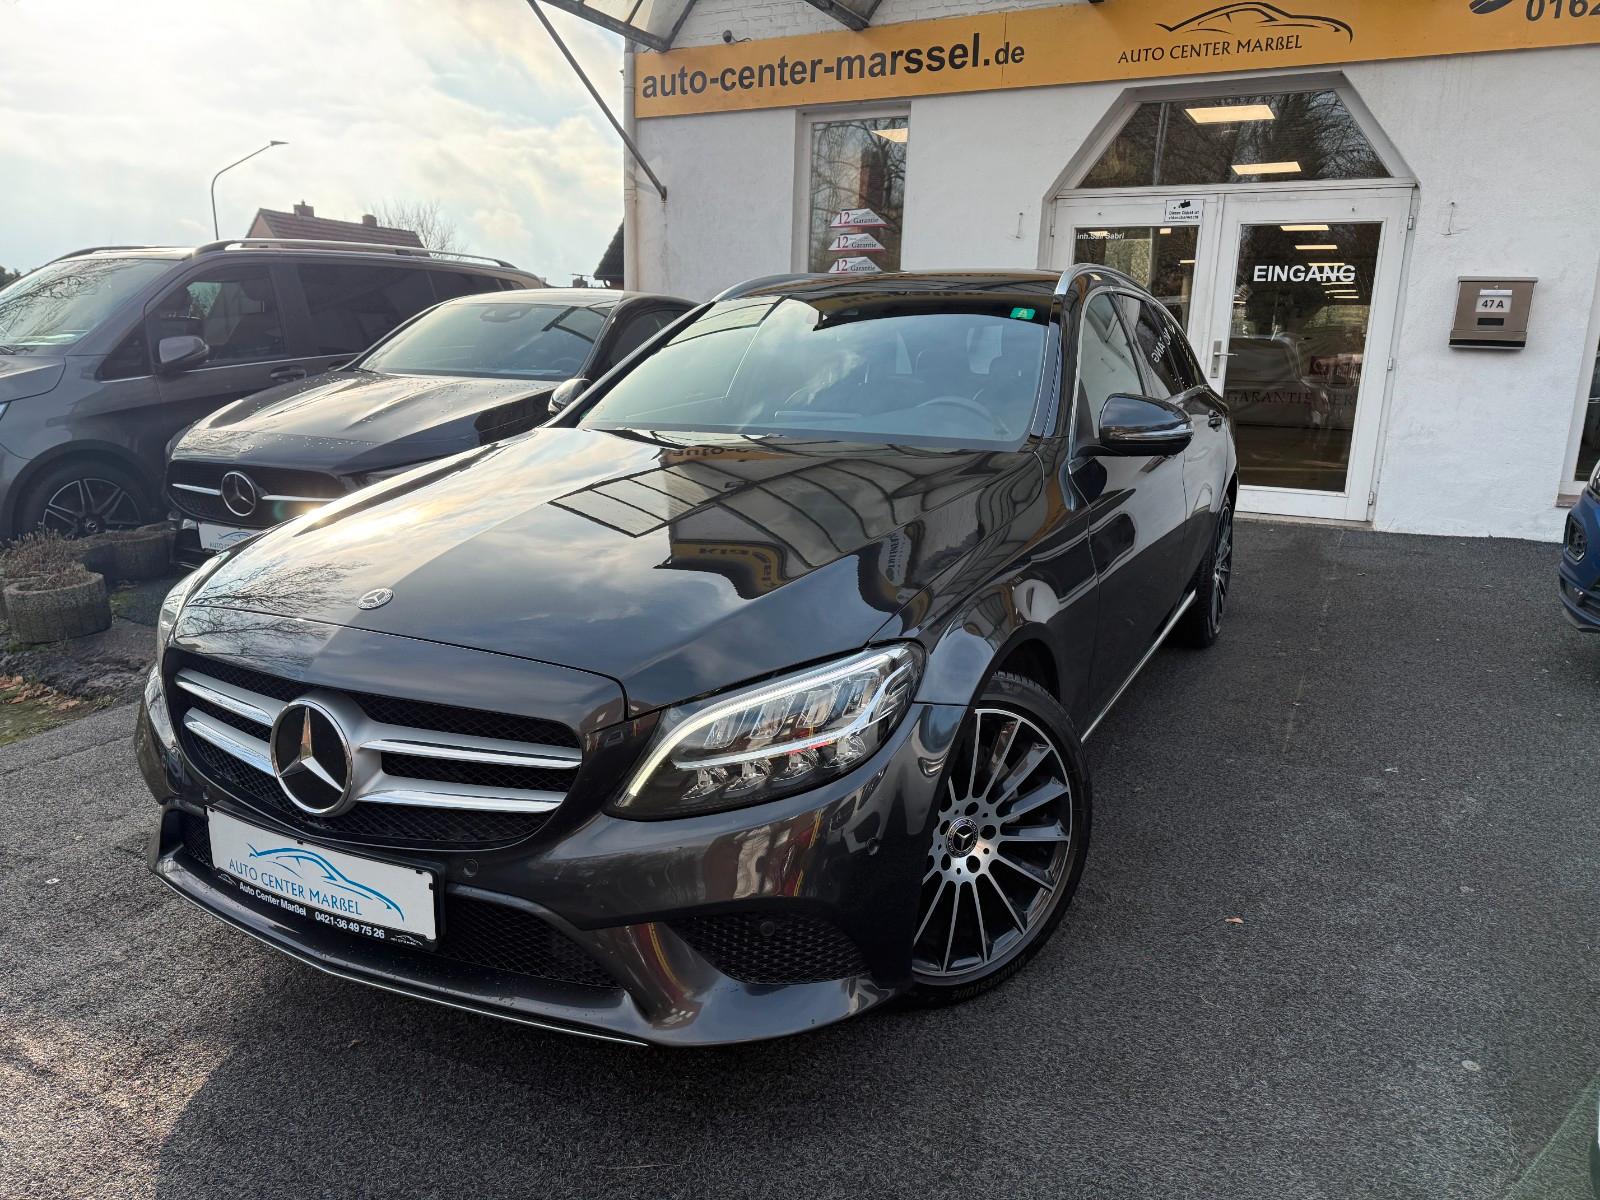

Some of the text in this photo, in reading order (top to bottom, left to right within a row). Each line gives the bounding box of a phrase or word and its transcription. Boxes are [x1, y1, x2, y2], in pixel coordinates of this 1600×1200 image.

[1118, 47, 1164, 63] AUTO
[1170, 41, 1230, 59] CENTER
[642, 33, 1025, 98] auto-center-marssel.de
[837, 211, 850, 224] 12
[836, 236, 877, 249] 12 Garantie
[835, 259, 848, 272] 12
[1253, 264, 1356, 282] EINGANG
[1481, 299, 1505, 309] 47 A
[229, 858, 258, 881] AUTO
[260, 872, 306, 899] CENTER
[239, 881, 255, 896] Auto
[255, 887, 280, 906] Center
[314, 911, 348, 930] 0421-36
[348, 922, 360, 933] 49
[360, 924, 372, 936] 75
[372, 927, 385, 939] 26
